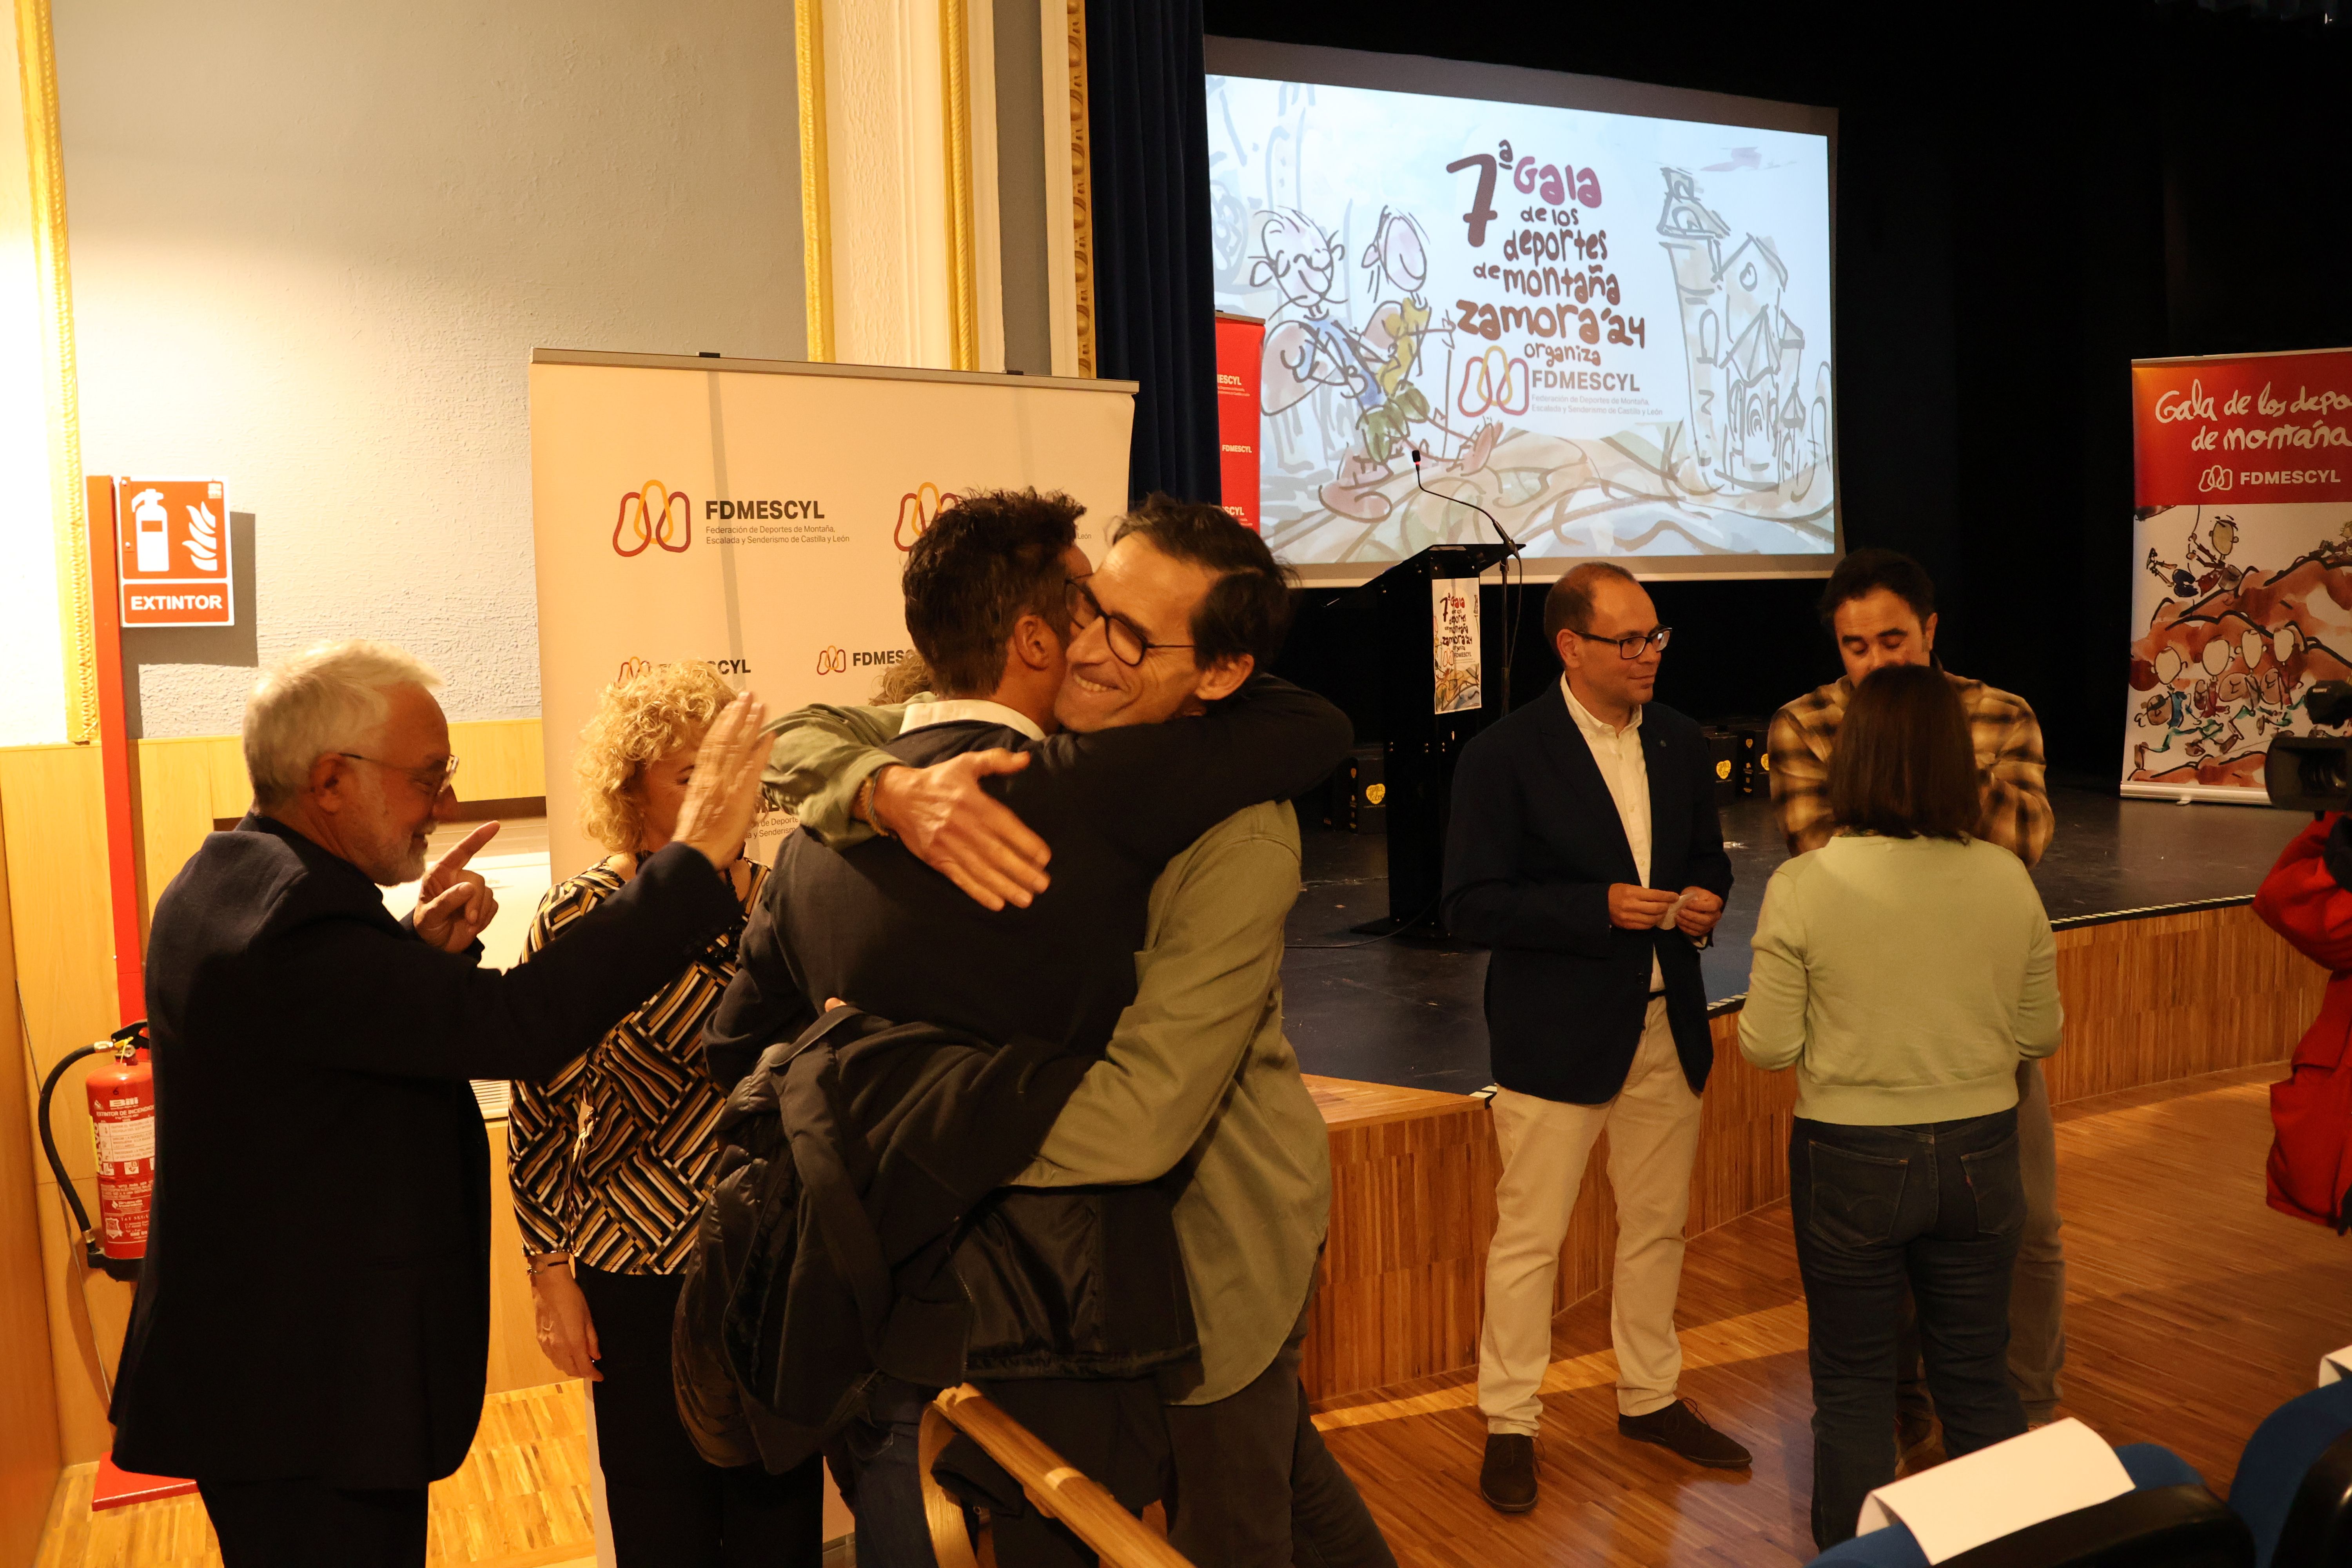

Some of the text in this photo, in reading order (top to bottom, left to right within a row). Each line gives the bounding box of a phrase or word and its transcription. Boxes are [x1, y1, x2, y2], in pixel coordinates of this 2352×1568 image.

[1514, 156, 1601, 208] Gala
[1521, 206, 1579, 226] de los
[1504, 229, 1607, 267] deportes
[1473, 262, 1620, 305] de montaña
[1524, 343, 1601, 367] organiza
[1532, 370, 1640, 392] FDMESCYL
[2156, 379, 2218, 423] Gala
[2224, 390, 2251, 415] de
[2258, 381, 2287, 417] los
[1568, 405, 1606, 414] Senderismo
[2191, 420, 2352, 451] de montaña
[1222, 445, 1252, 453] FDMESCYL
[2241, 470, 2341, 485] FDMESCYL
[706, 500, 825, 519] FDMESCYL
[760, 526, 792, 534] Deportes
[804, 525, 835, 533] Montaña,
[131, 595, 222, 610] EXTINTOR
[1451, 596, 1465, 608] Gala
[1449, 614, 1466, 625] deportes
[1449, 623, 1468, 634] montaña
[771, 817, 799, 826] Deporte
[759, 827, 796, 837] Senderism
[128, 1105, 154, 1114] INCENDIO
